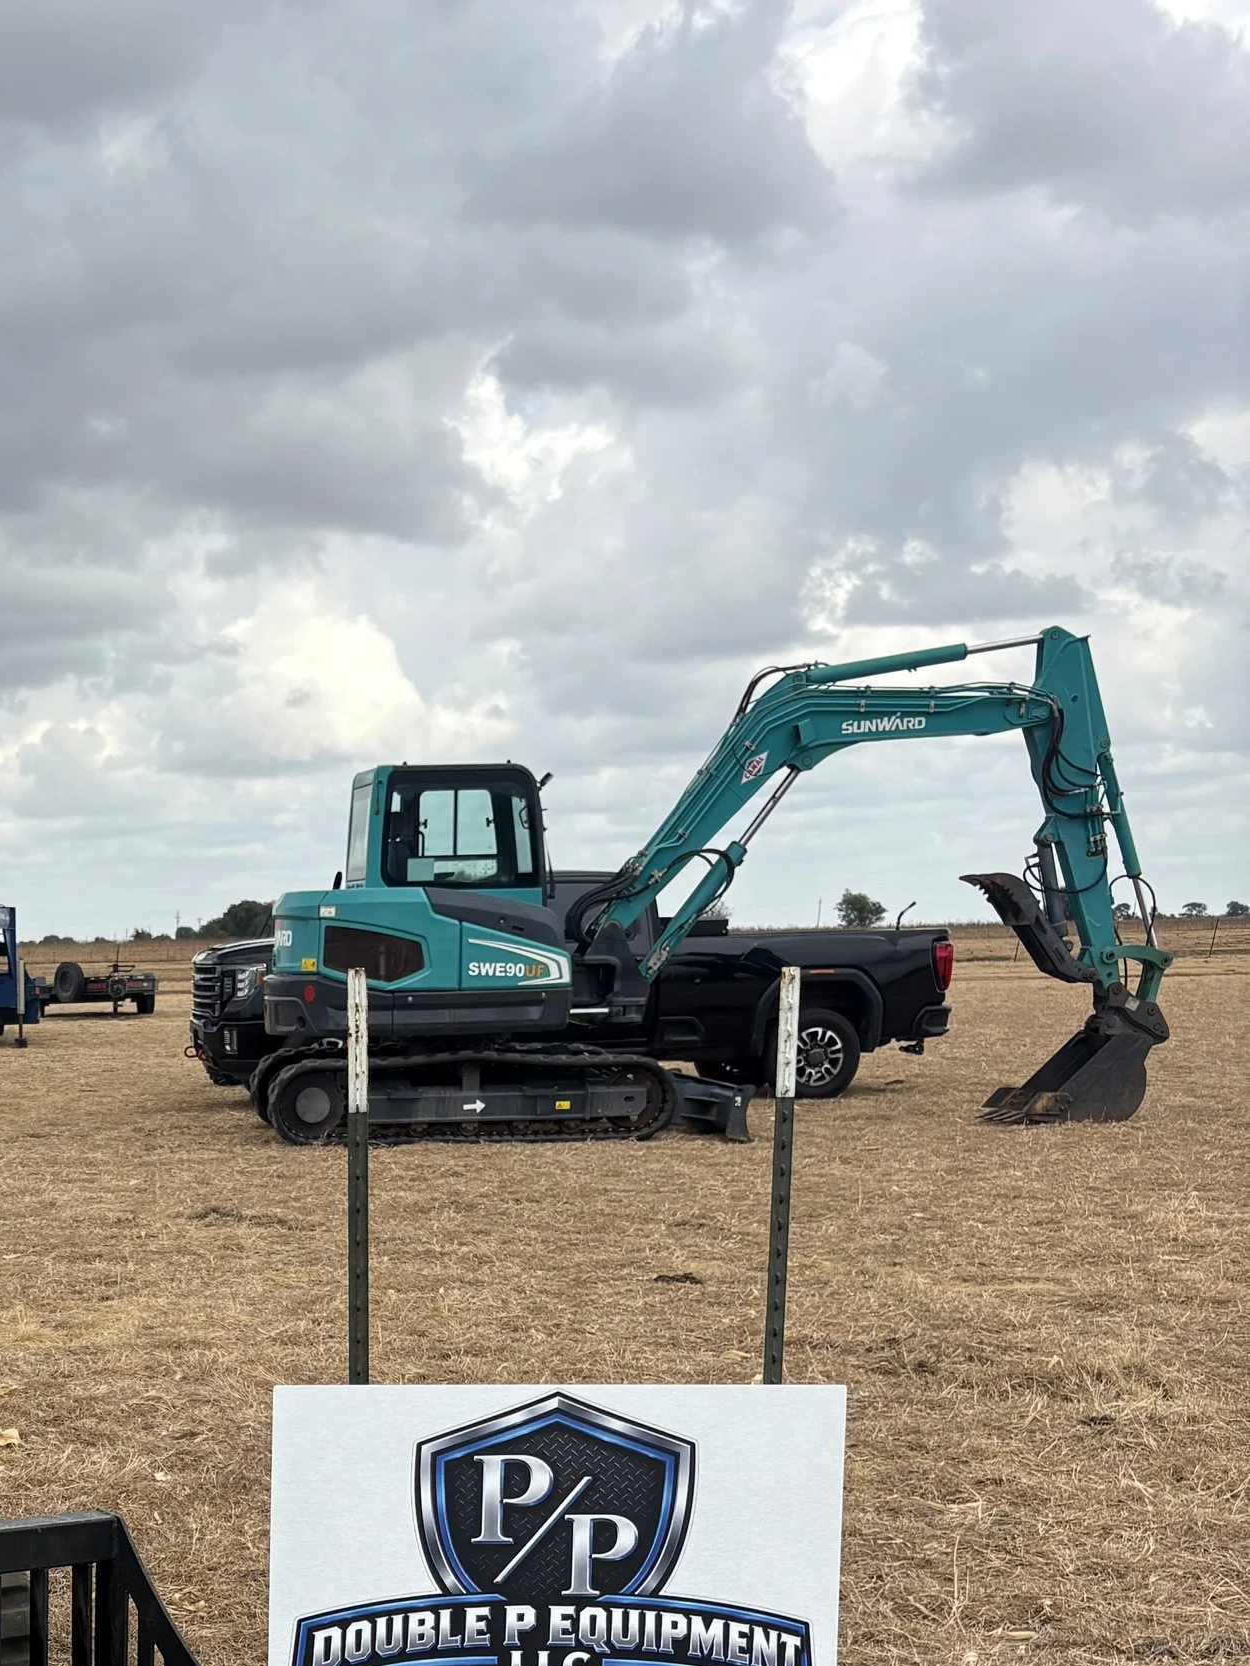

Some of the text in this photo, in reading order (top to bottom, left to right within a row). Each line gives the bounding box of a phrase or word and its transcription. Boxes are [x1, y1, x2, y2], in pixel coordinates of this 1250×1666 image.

[841, 712, 926, 734] SUNWARD
[468, 961, 544, 977] SWE90UF
[502, 1604, 538, 1647] P
